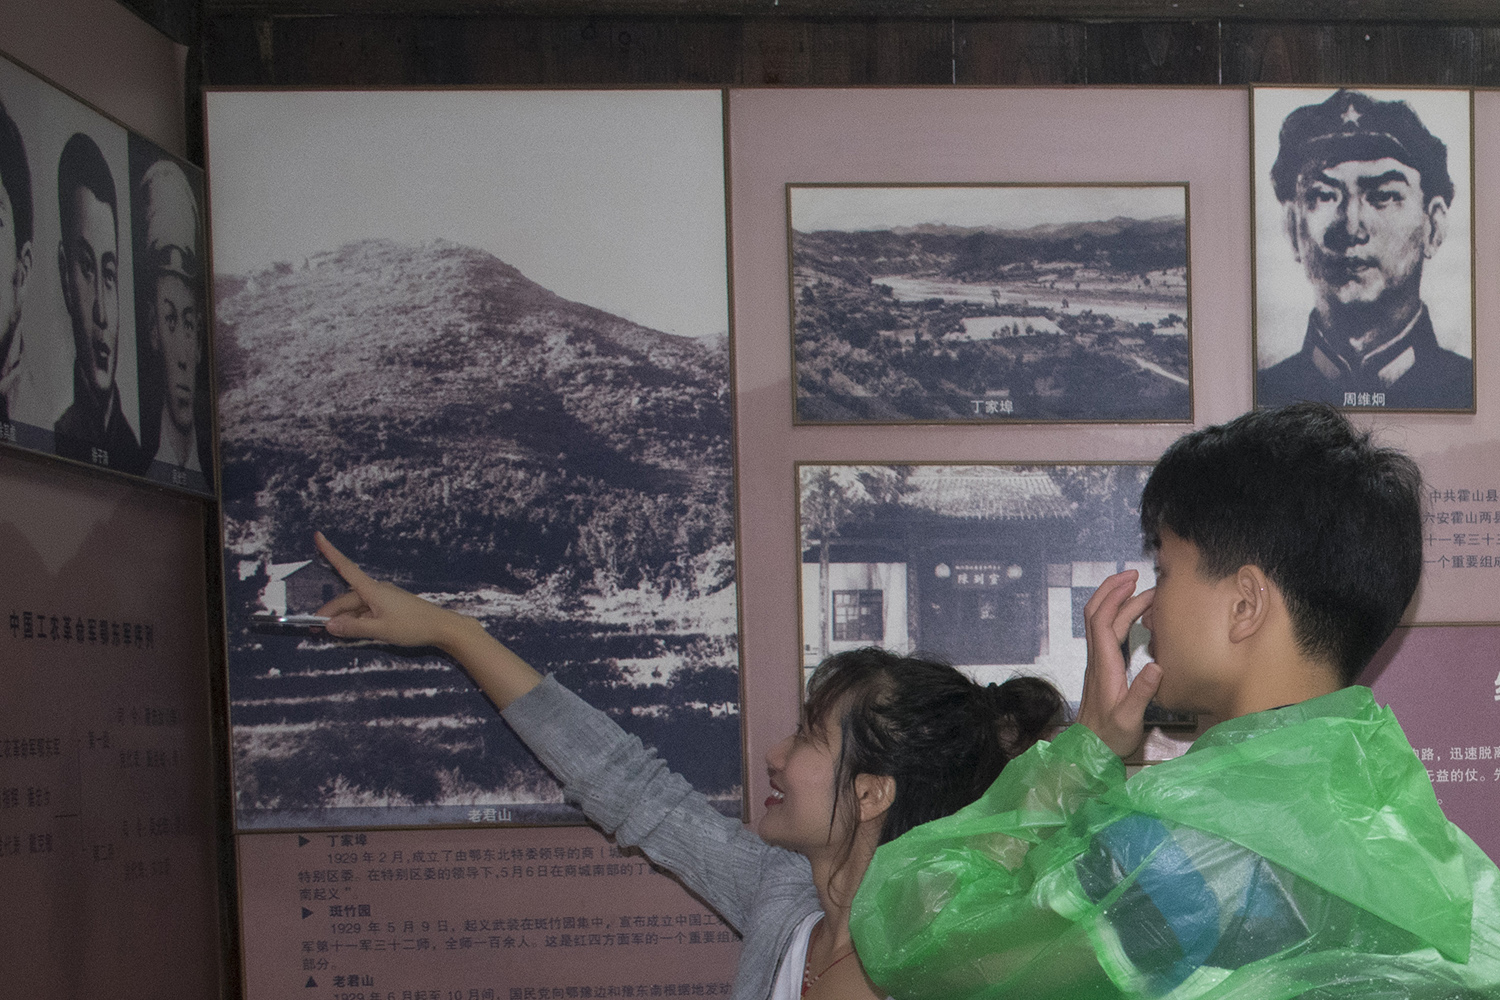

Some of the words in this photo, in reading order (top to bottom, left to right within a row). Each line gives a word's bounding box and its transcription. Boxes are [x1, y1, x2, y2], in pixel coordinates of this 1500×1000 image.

[1342, 391, 1386, 407] 周维炯
[971, 400, 1014, 415] 丁家埠
[467, 807, 513, 823] 老君山
[332, 974, 375, 989] 老君山
